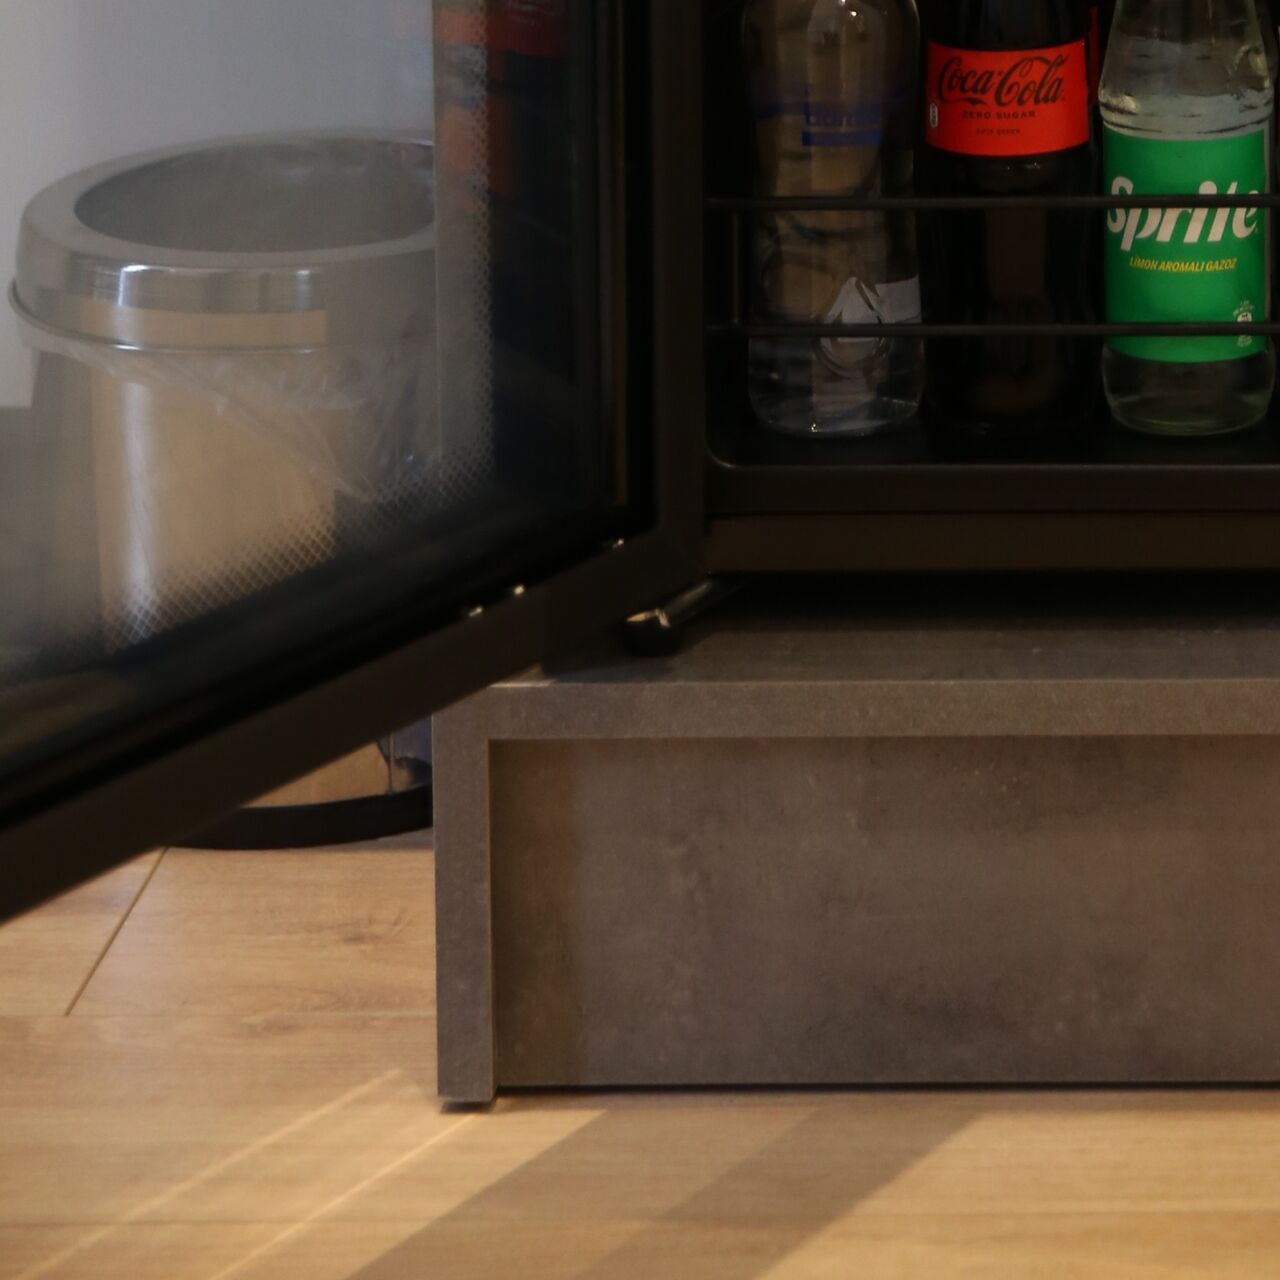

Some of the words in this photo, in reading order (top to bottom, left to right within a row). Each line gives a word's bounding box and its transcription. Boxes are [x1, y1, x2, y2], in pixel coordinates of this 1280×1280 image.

[938, 53, 1070, 107] Coca-Cola
[962, 110, 992, 120] ZERO
[996, 109, 1037, 120] SUGAR
[1106, 175, 1259, 253] Sprite
[1158, 259, 1206, 273] AROMALI
